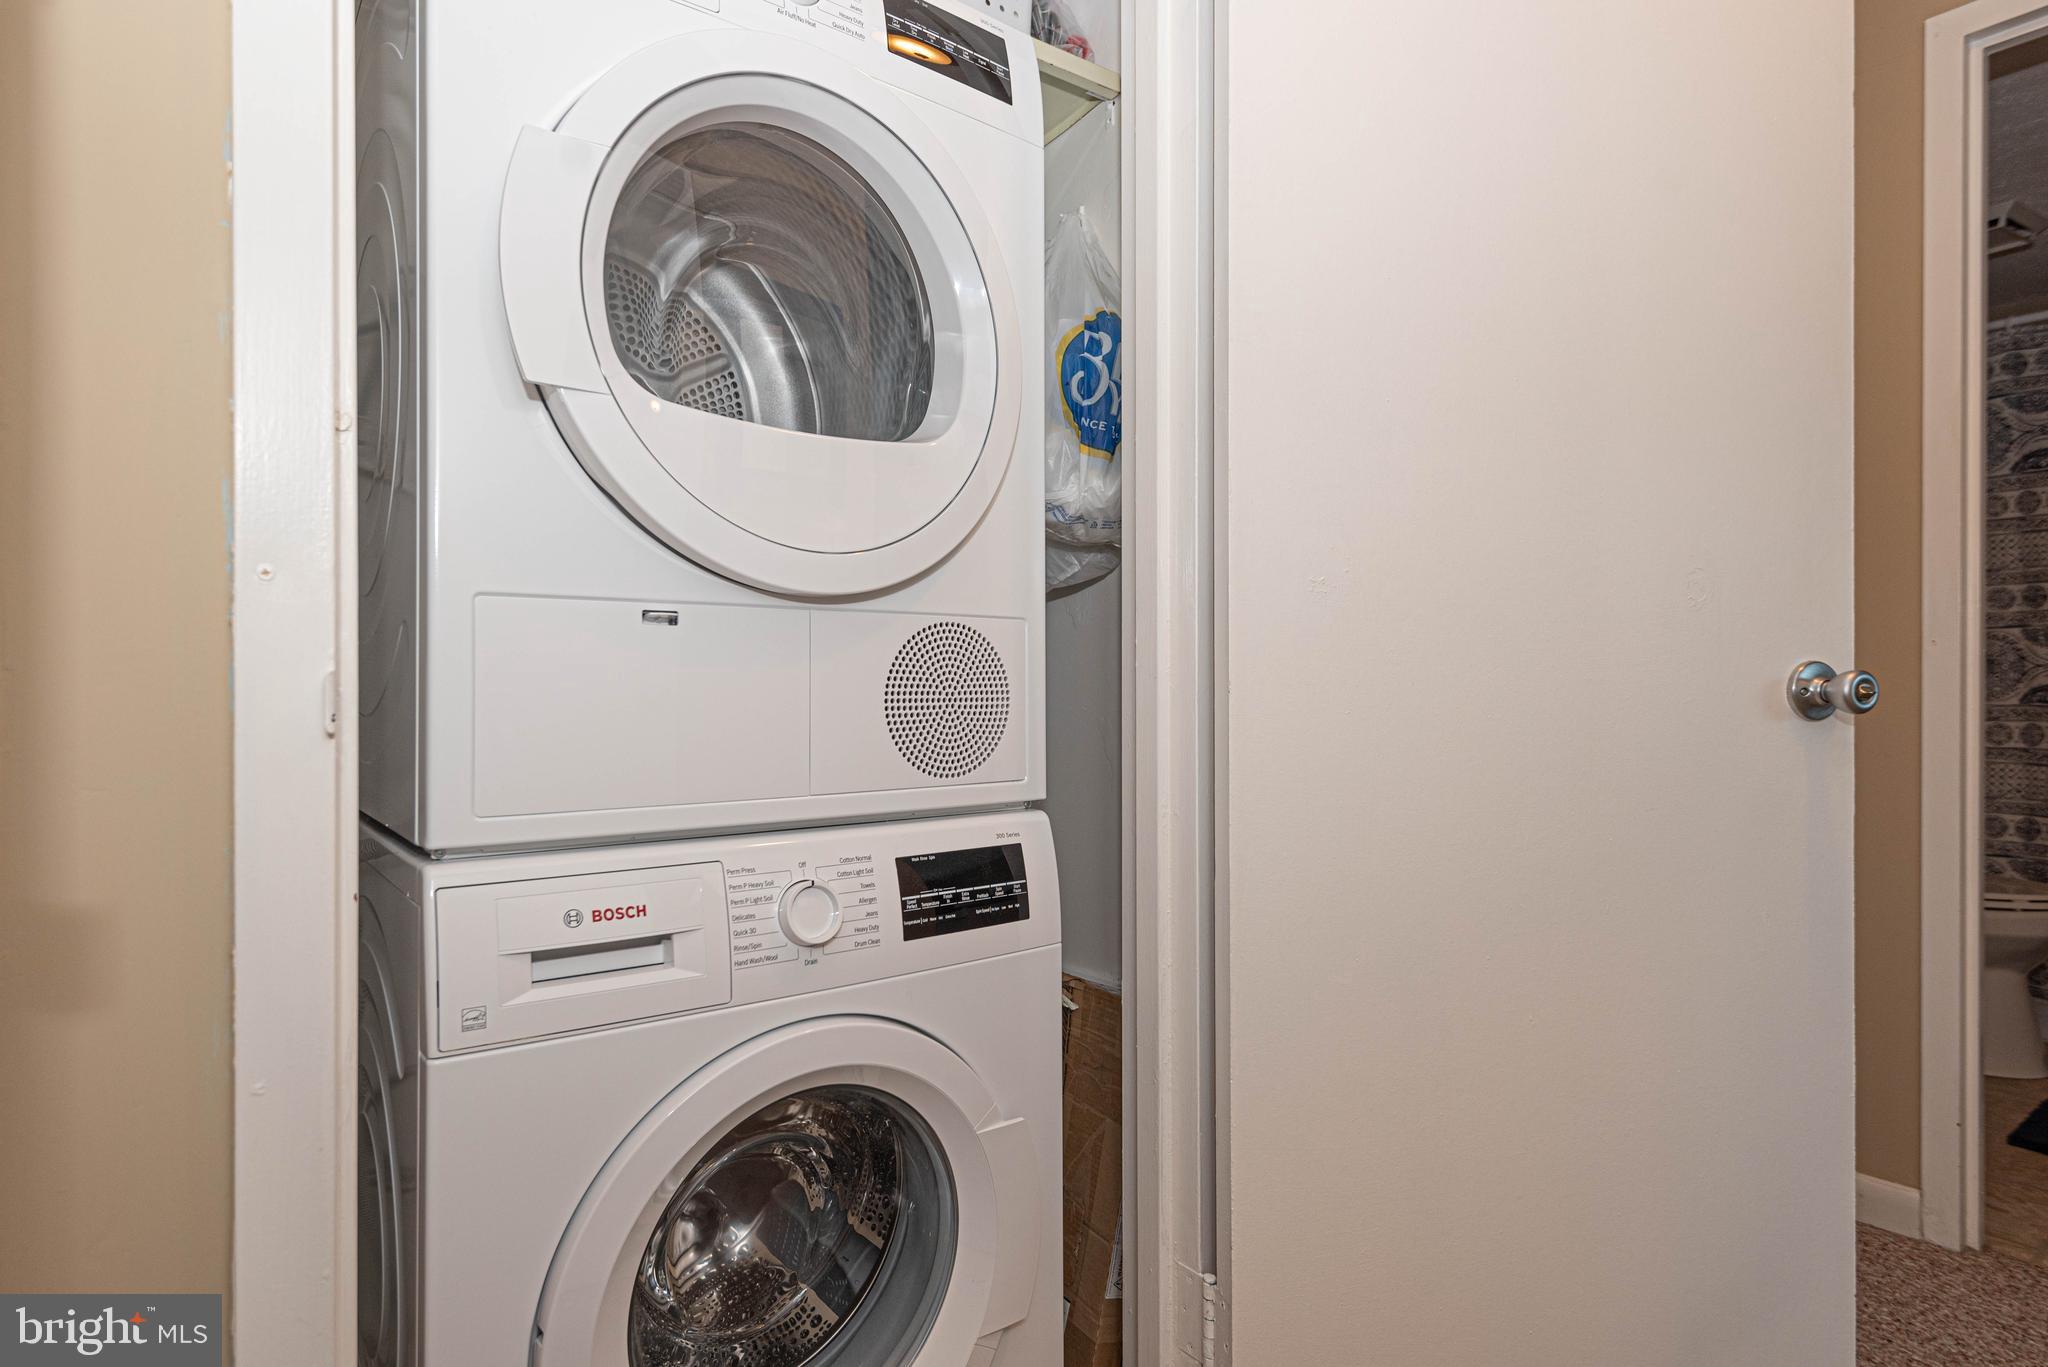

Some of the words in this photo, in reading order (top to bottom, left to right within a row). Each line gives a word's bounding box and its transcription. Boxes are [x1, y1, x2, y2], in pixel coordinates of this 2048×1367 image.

[805, 18, 817, 28] Heat
[832, 21, 845, 31] Quick
[846, 27, 854, 36] Dry
[855, 31, 866, 40] Auto
[853, 869, 864, 877] Light
[748, 881, 764, 889] Heavy
[749, 896, 763, 904] Light
[859, 896, 877, 904] Allergen
[591, 904, 648, 923] BOSCH
[854, 925, 868, 933] Heavy
[869, 924, 880, 932] Duty
[734, 943, 762, 952] Rinse/Spin
[854, 940, 867, 948] Drum
[750, 954, 778, 963] Wash/Wool
